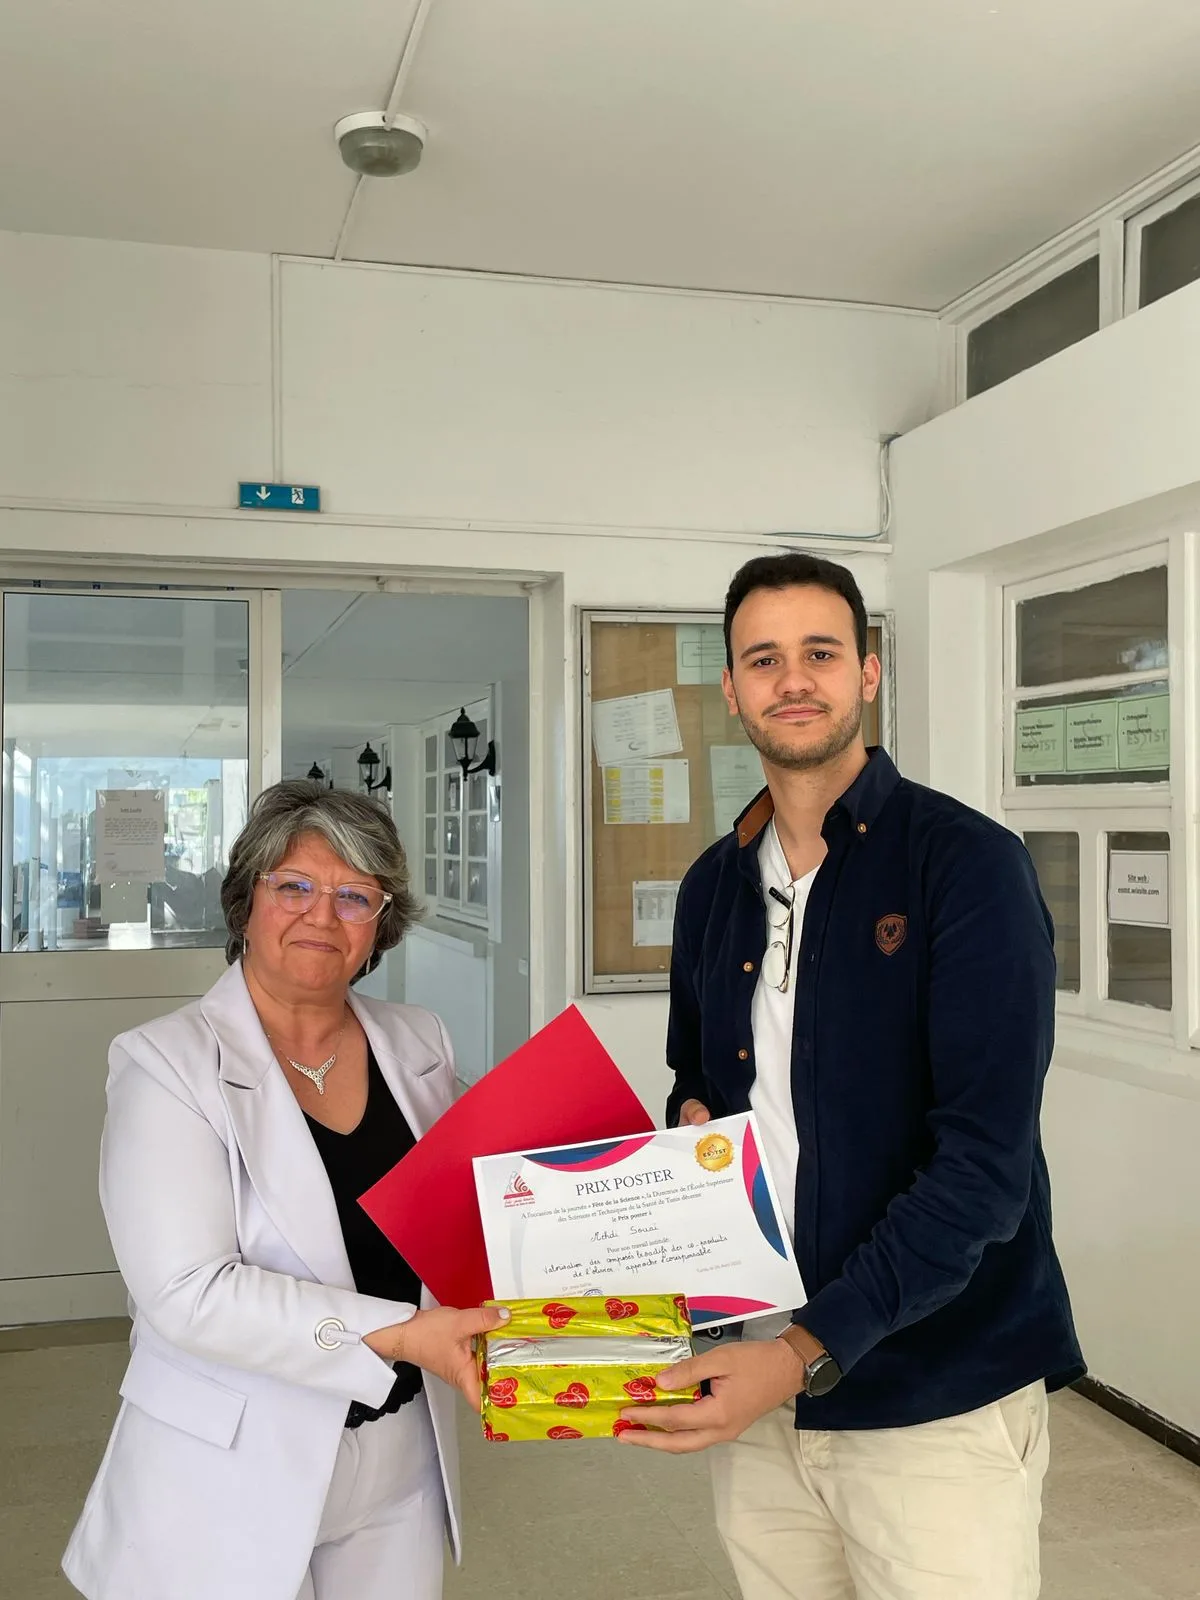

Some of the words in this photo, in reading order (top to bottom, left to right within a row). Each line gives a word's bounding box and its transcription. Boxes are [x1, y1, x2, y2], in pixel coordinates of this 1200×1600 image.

[575, 1178, 611, 1196] PRIX
[613, 1168, 675, 1190] POSTER
[567, 1204, 587, 1213] journée
[619, 1195, 641, 1204] Science
[652, 1187, 679, 1198] Directrice
[705, 1177, 734, 1189] Supérieure
[567, 1211, 591, 1221] Sciences
[597, 1205, 628, 1217] Techniques
[641, 1199, 657, 1208] Santé
[666, 1196, 681, 1204] Tunis
[617, 1213, 629, 1221] Prix
[630, 1210, 648, 1220] poster
[631, 1241, 649, 1250] travail
